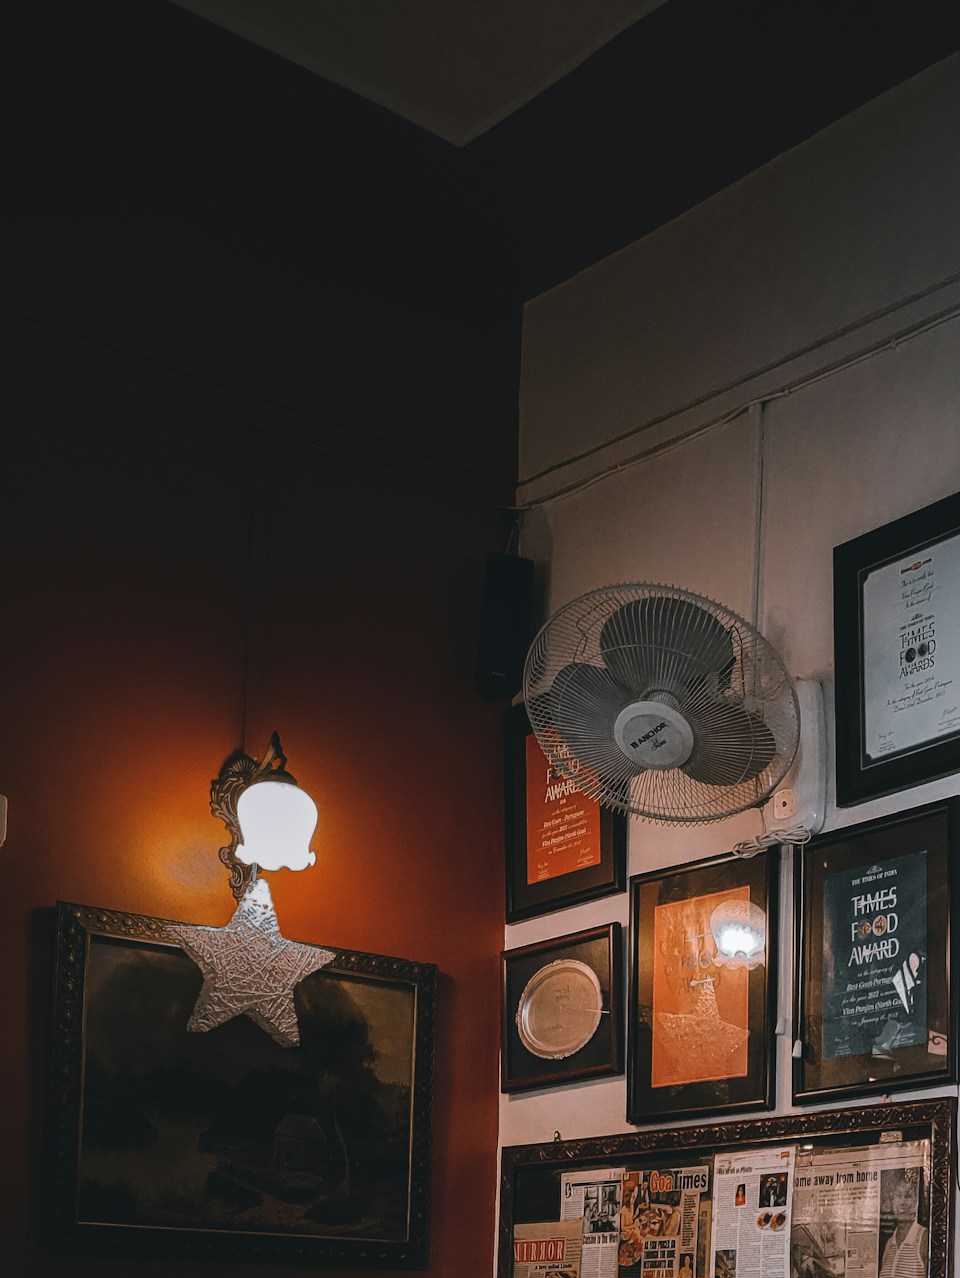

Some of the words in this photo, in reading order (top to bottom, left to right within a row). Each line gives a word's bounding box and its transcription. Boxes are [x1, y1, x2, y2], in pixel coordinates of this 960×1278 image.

[899, 621, 936, 650] TIMES
[899, 639, 937, 667] FOOD
[899, 655, 936, 679] AWARDS
[637, 722, 668, 745] ANCHOR
[851, 886, 897, 917] TIMES
[851, 912, 899, 942] FOOD
[848, 937, 900, 967] AWARD
[813, 1174, 834, 1187] away
[836, 1171, 854, 1185] from
[856, 1170, 878, 1183] home
